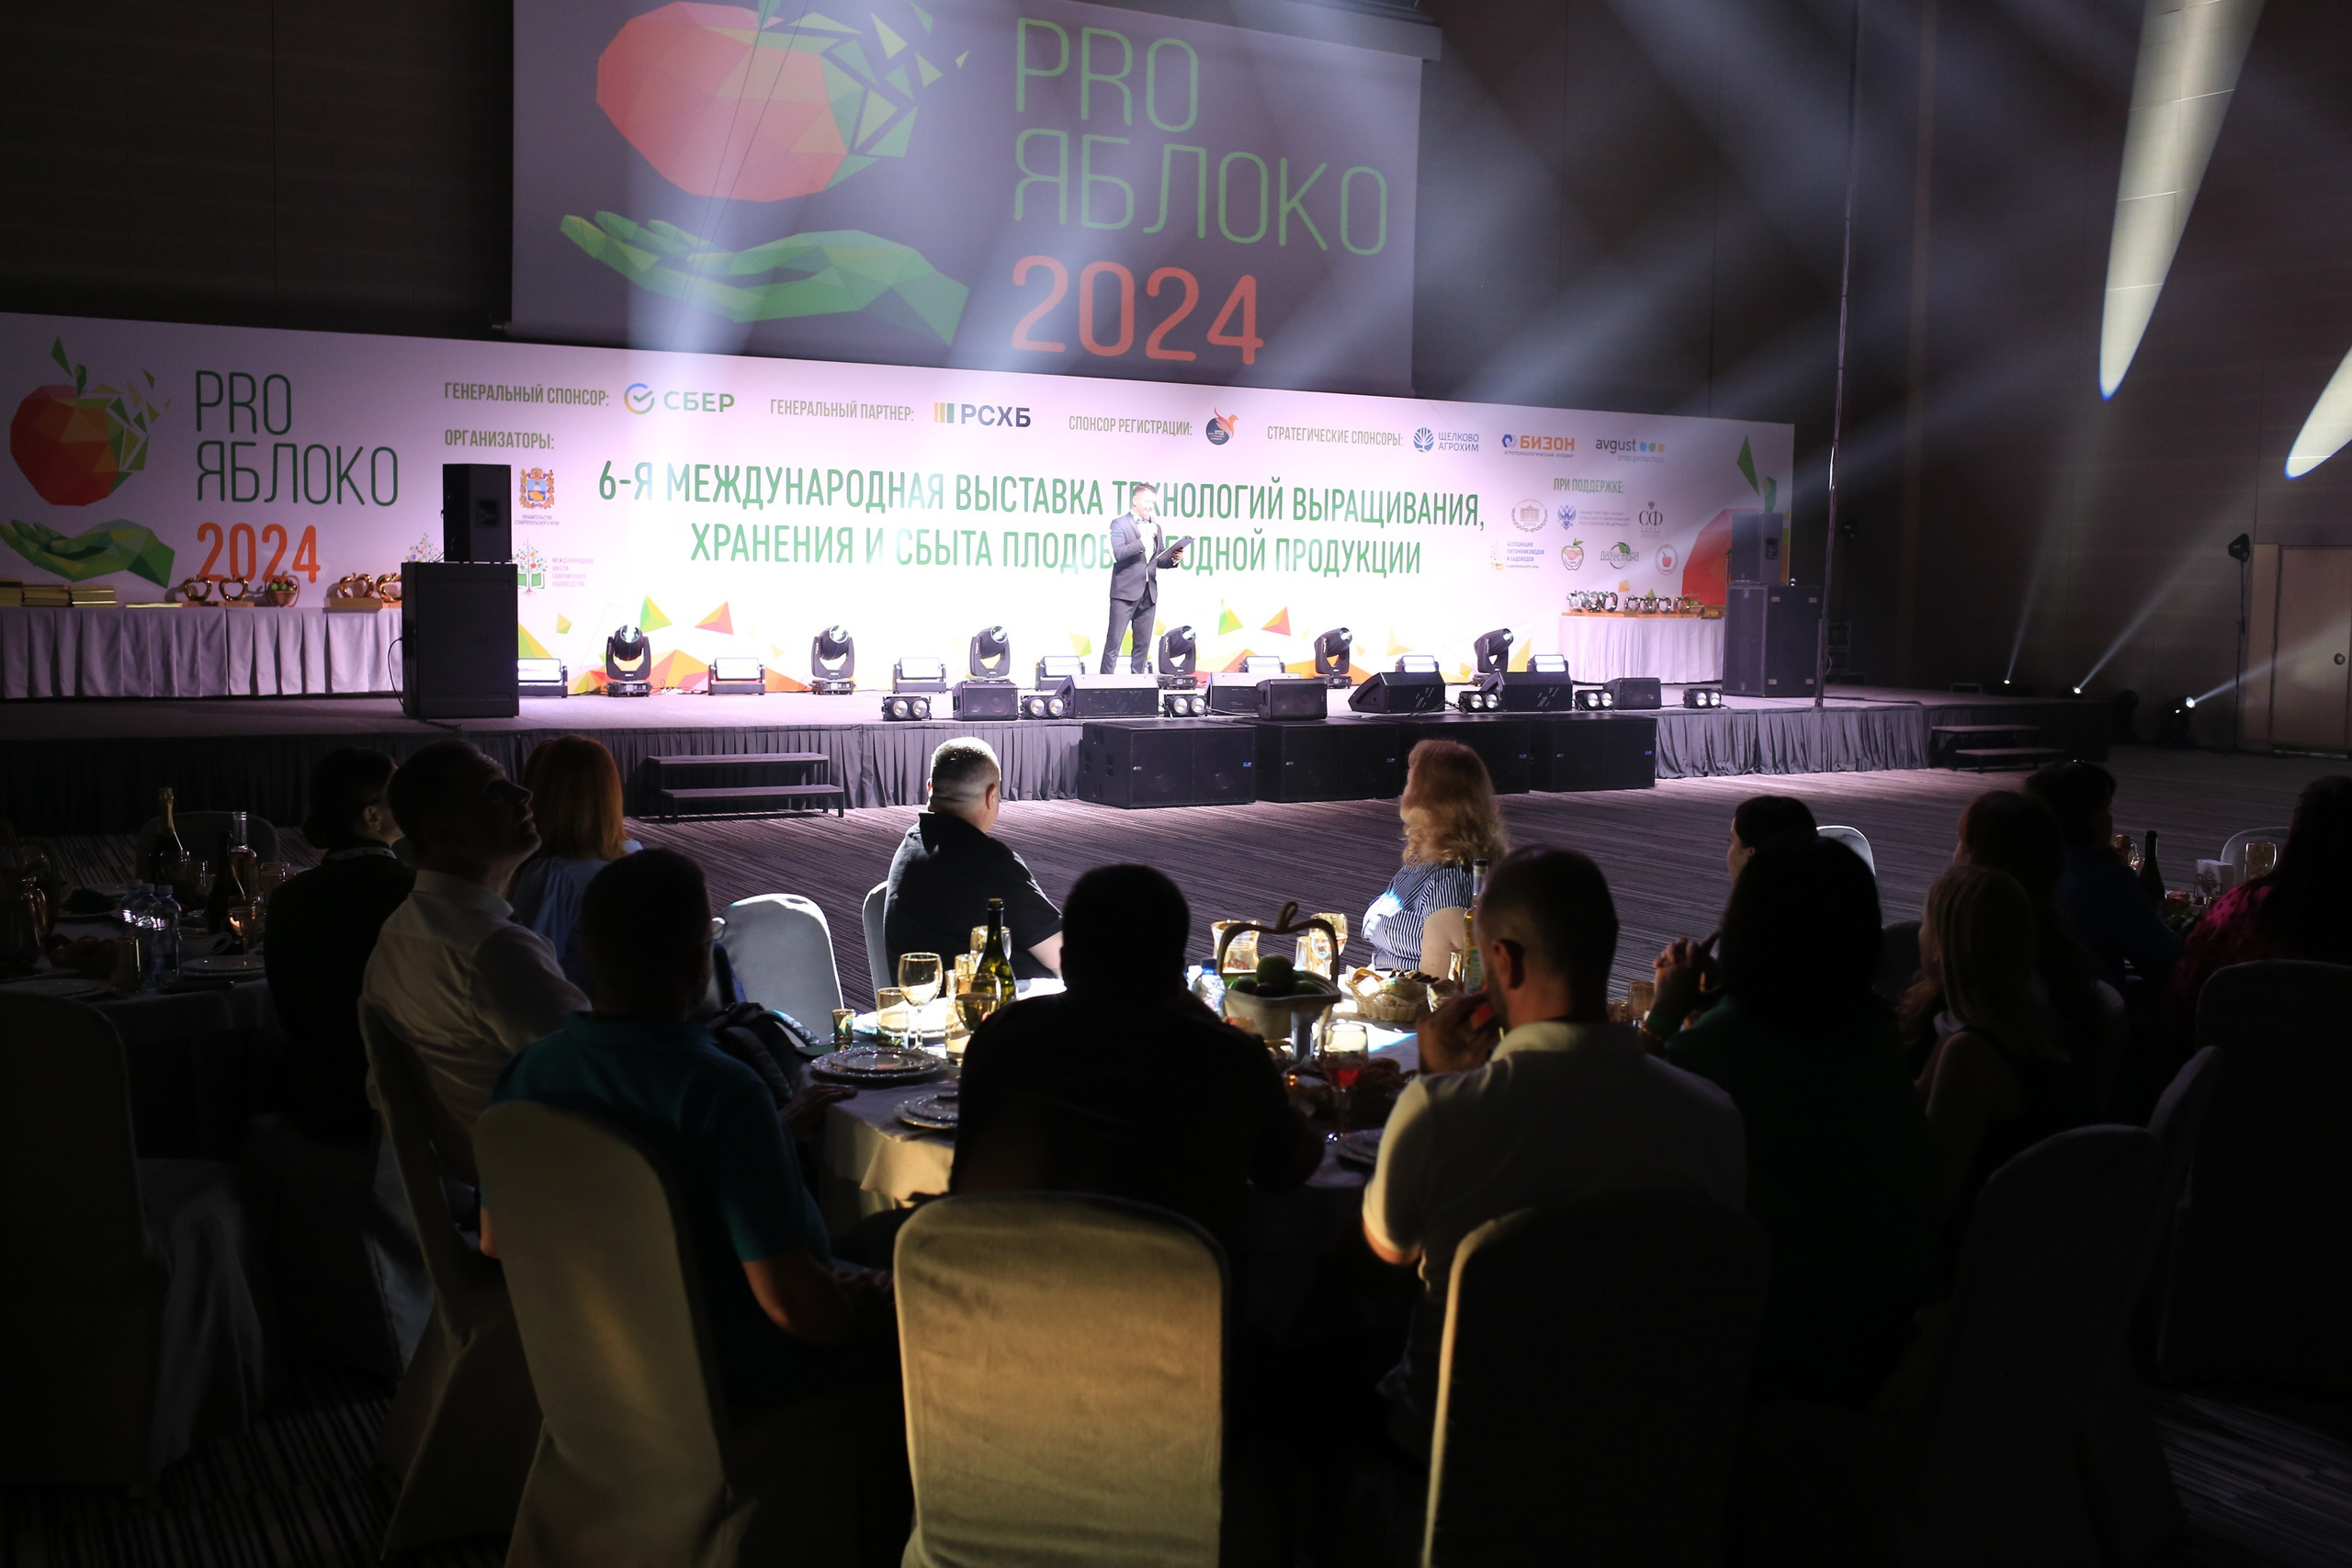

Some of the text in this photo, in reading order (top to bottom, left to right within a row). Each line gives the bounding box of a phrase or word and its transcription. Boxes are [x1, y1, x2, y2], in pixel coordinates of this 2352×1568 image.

[1014, 17, 1199, 132] PRO
[1013, 127, 1388, 256] ЯБЛОКО
[1012, 255, 1264, 366] 2024
[195, 369, 291, 435] PRO
[444, 381, 610, 407] ГЕНЕРАЛЬНЫЙ СПОНСОР:
[662, 389, 736, 412] СБЕР
[770, 399, 914, 422] ГЕНЕРАЛЬНЫЙ ПАРТНЕР:
[960, 404, 1032, 428] РСХБ
[1069, 415, 1193, 436] СПОНСОР РЕГИСТРАЦИИ:
[1267, 424, 1404, 446] СТРАТЕГИЧЕСКИЕ СПОНСОРЫ:
[444, 428, 555, 450] ОРГАНИЗАТОРЫ:
[1438, 432, 1480, 444] ЩЕЛКОВО
[1438, 442, 1480, 453] АГРОХИМ
[1520, 434, 1576, 452] БИЗОН
[1595, 438, 1637, 457] avgust
[1617, 453, 1665, 464] crop protection
[196, 440, 399, 506] ЯБЛОКО
[598, 460, 653, 501] 6-Я
[667, 462, 944, 513] МЕЖДУНАРОДНАЯ
[956, 473, 1103, 515] ВЫСТАВКА
[1293, 487, 1485, 531] ВЫРАЩИВАНИЯ,
[1554, 478, 1625, 494] ПРИ ПОДДЕРЖКЕ:
[1638, 510, 1664, 527] СФ
[196, 521, 321, 583] 2024
[691, 523, 854, 564] ХРАНЕНИЯ
[865, 526, 884, 565] И
[896, 527, 993, 567] СБЫТА
[1275, 537, 1420, 579] ПРОДУКЦИИ
[1600, 550, 1640, 563] Дагестана
